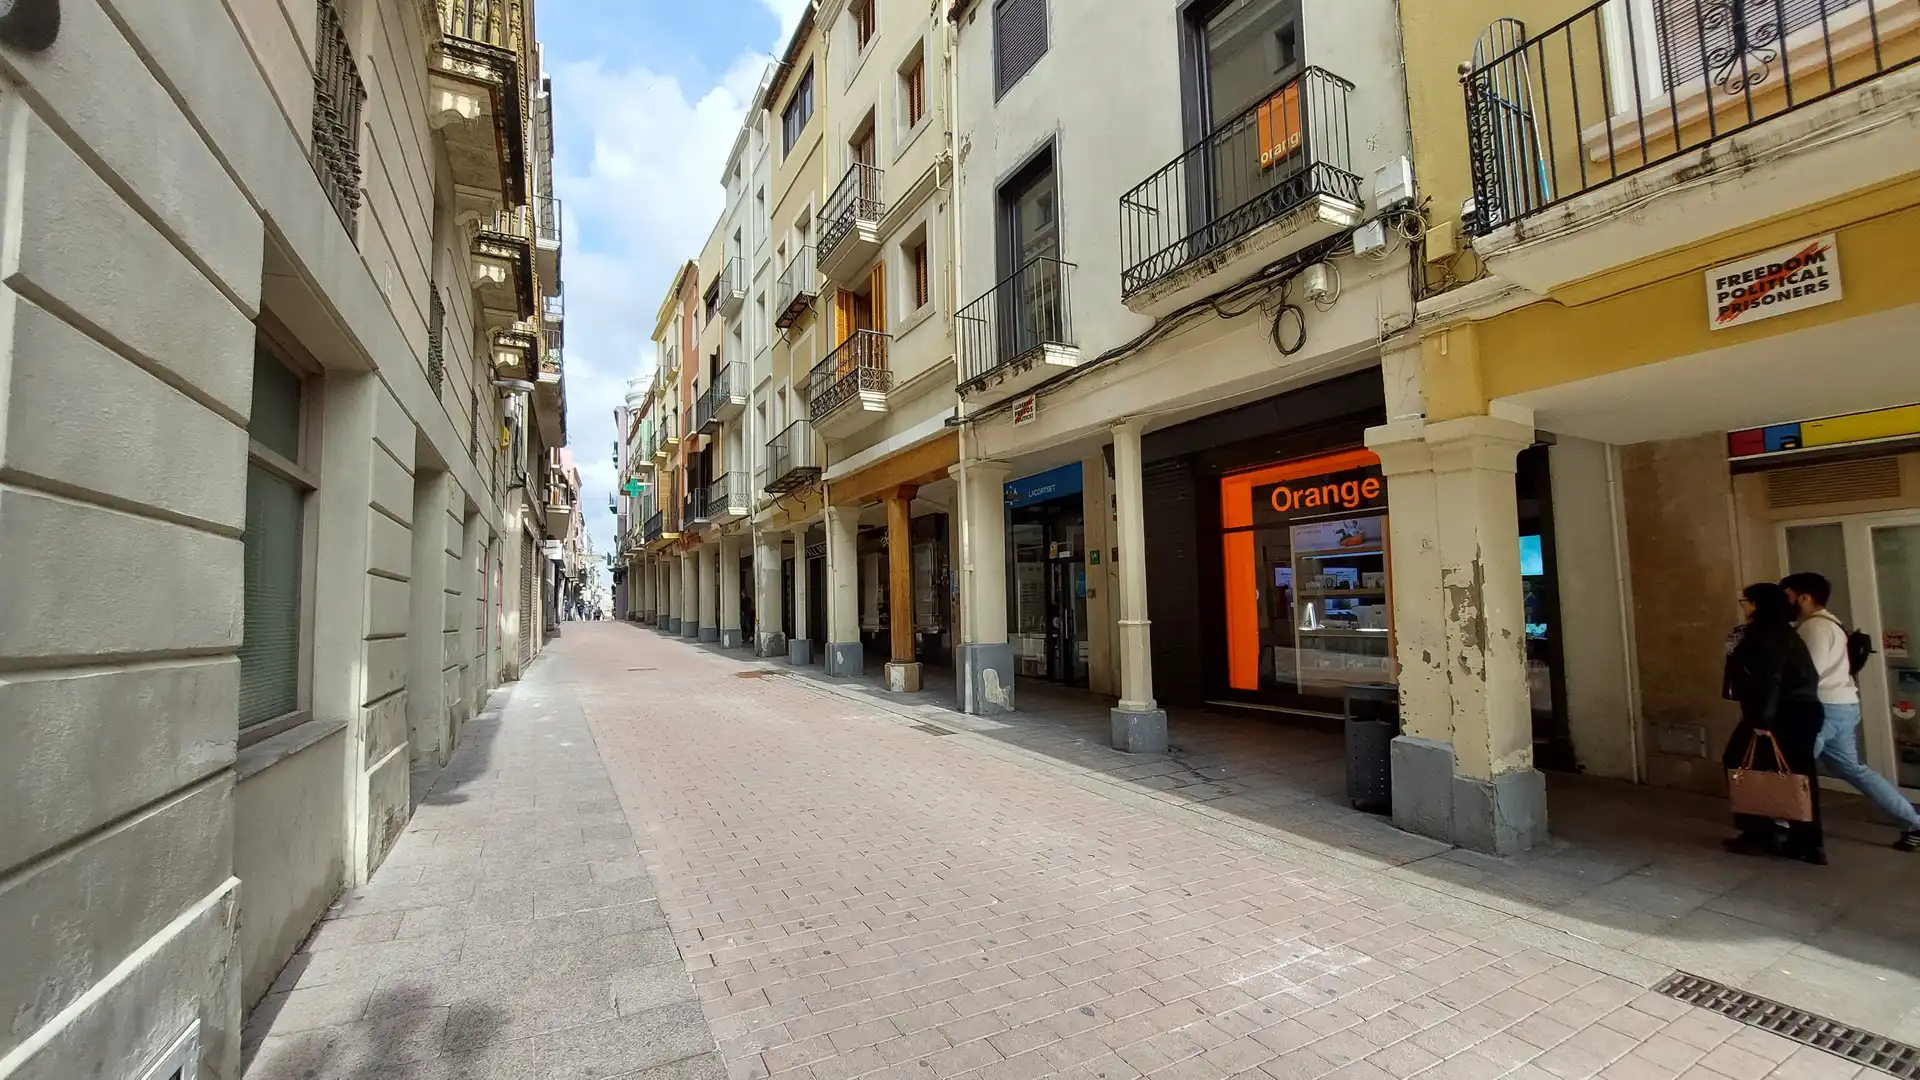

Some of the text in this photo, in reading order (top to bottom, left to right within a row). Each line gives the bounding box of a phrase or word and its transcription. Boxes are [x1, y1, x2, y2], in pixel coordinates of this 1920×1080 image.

[1261, 131, 1300, 163] orang
[1716, 251, 1825, 290] FREEDOM
[1717, 265, 1829, 303] POLITICAL
[1718, 279, 1830, 317] PRISONERS
[1271, 477, 1380, 512] Orange
